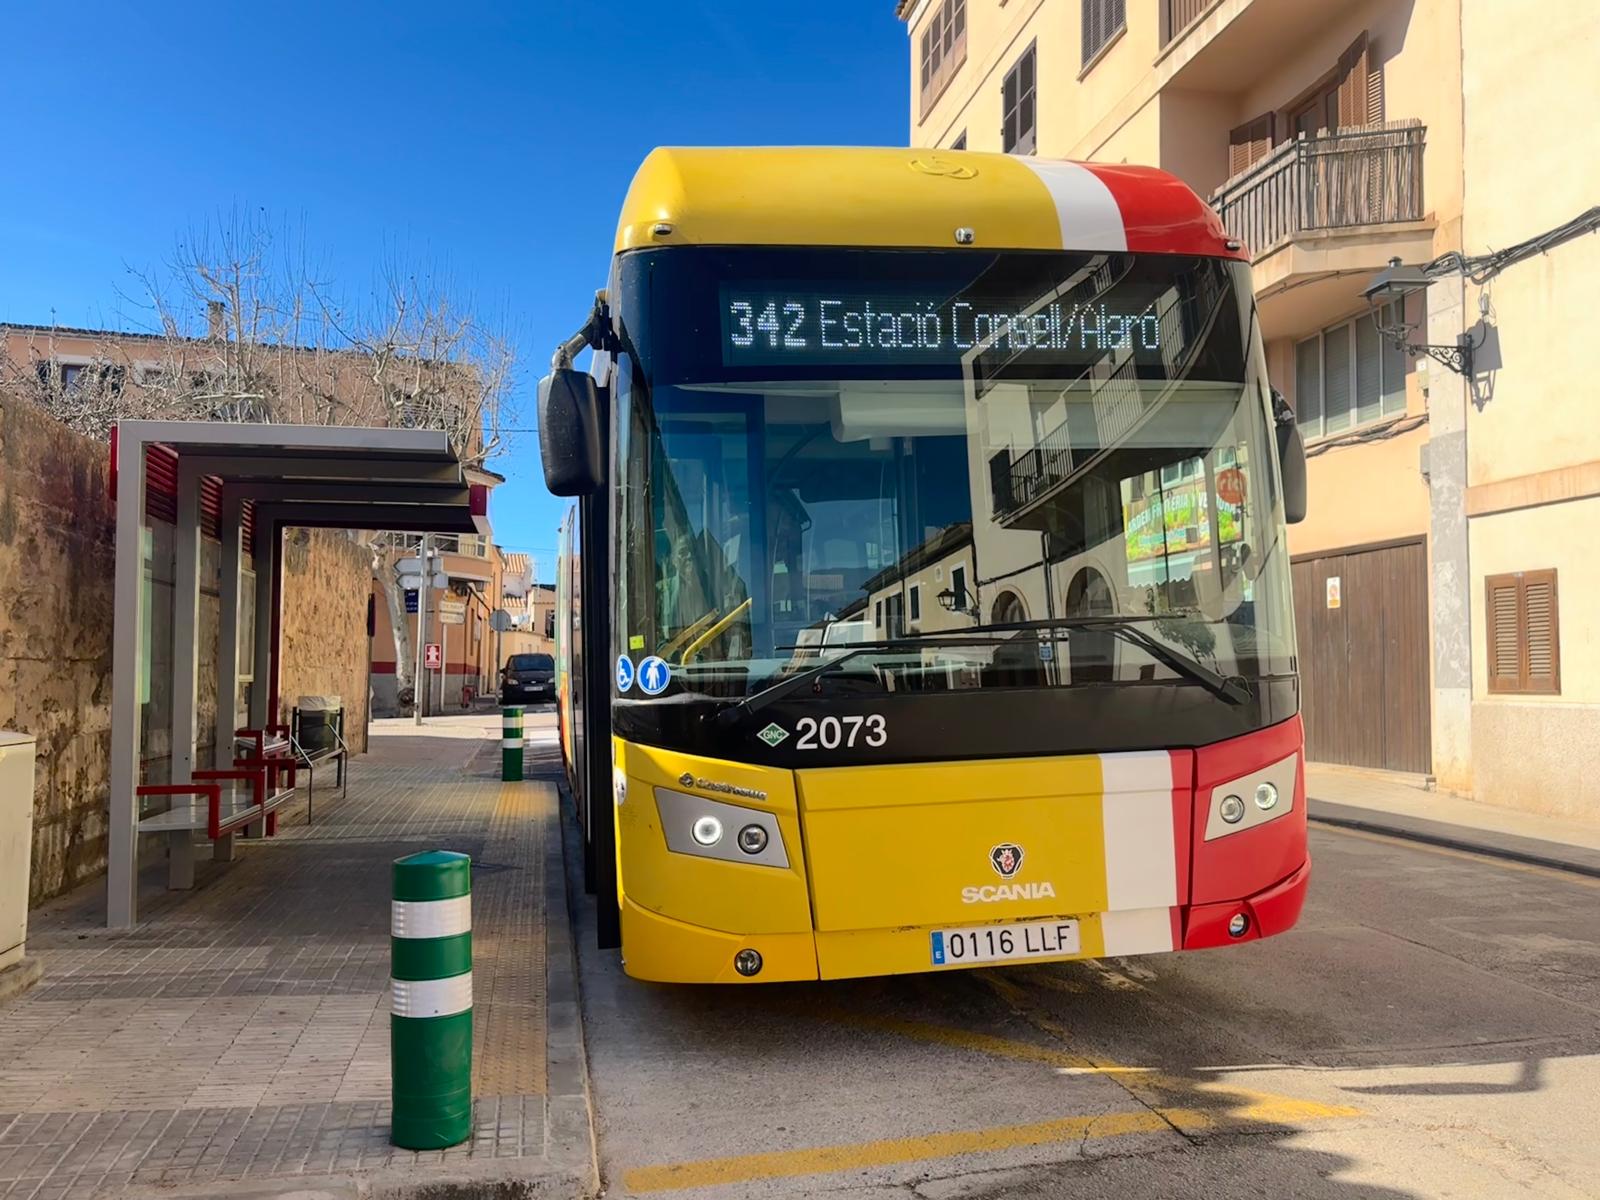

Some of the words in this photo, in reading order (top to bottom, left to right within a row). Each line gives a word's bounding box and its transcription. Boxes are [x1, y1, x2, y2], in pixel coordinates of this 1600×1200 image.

[730, 302, 806, 347] 342
[819, 300, 942, 348] Estació
[952, 302, 1160, 349] Consell/Alaró
[762, 729, 784, 740] GNC
[796, 714, 888, 750] 2073
[961, 881, 1056, 904] SCANIA
[935, 951, 942, 959] E
[949, 929, 1014, 959] 0116
[1024, 924, 1071, 953] LLF
